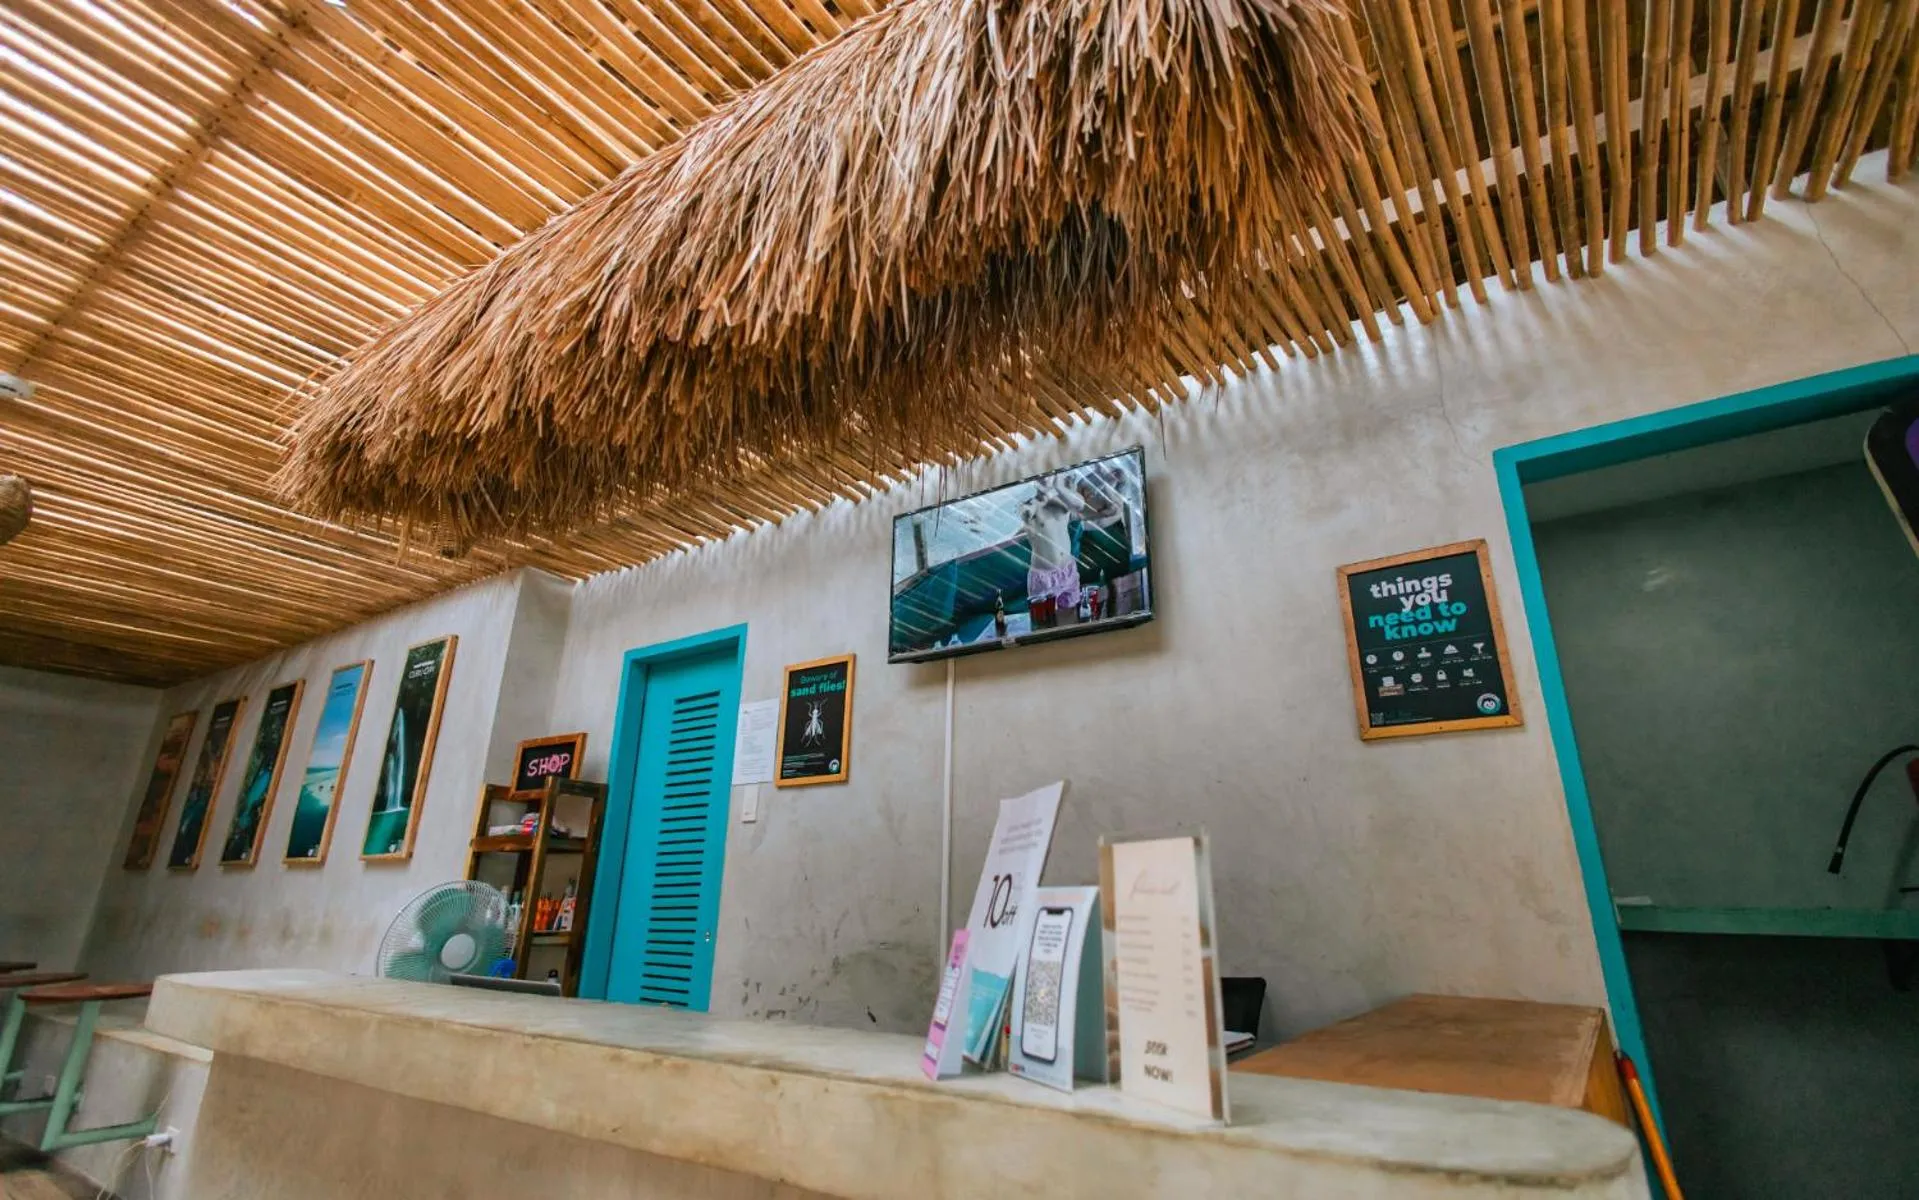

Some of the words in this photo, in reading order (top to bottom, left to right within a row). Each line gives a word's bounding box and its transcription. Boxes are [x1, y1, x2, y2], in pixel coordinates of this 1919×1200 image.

[1370, 573, 1453, 598] things
[1400, 589, 1448, 612] you
[1369, 604, 1432, 628] need
[1439, 602, 1467, 618] to
[1384, 618, 1457, 640] know
[790, 683, 816, 697] sand
[818, 679, 846, 693] flies!
[527, 752, 570, 777] SHOP
